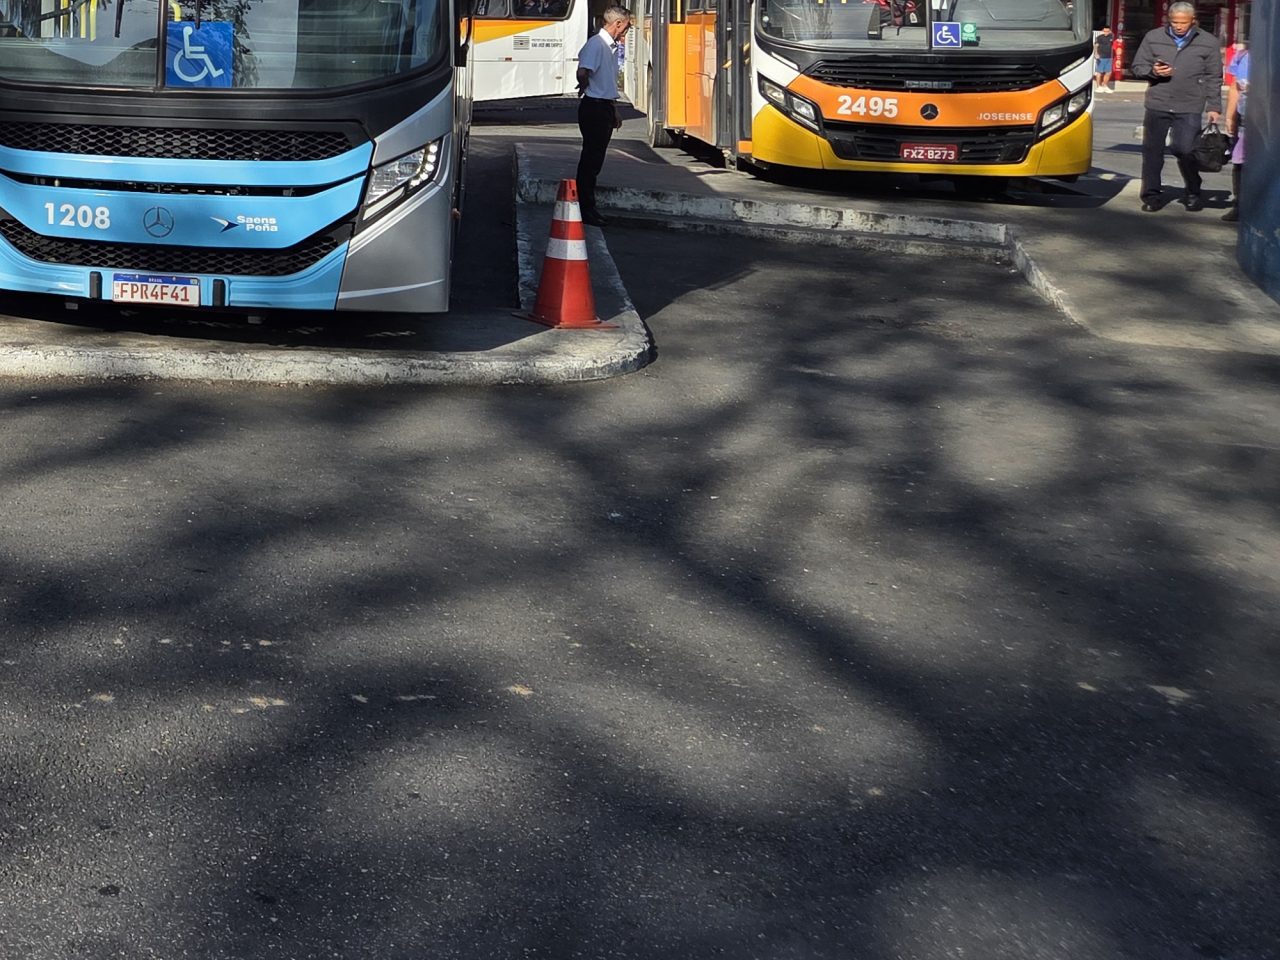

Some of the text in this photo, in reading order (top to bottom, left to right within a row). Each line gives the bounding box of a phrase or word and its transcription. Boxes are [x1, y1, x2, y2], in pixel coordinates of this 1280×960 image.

[837, 95, 898, 118] 2495
[978, 112, 1034, 121] JOSEENSE
[44, 202, 111, 230] 1208
[237, 215, 277, 224] Saens
[246, 223, 278, 232] Peña
[120, 283, 190, 302] FPR4F41
